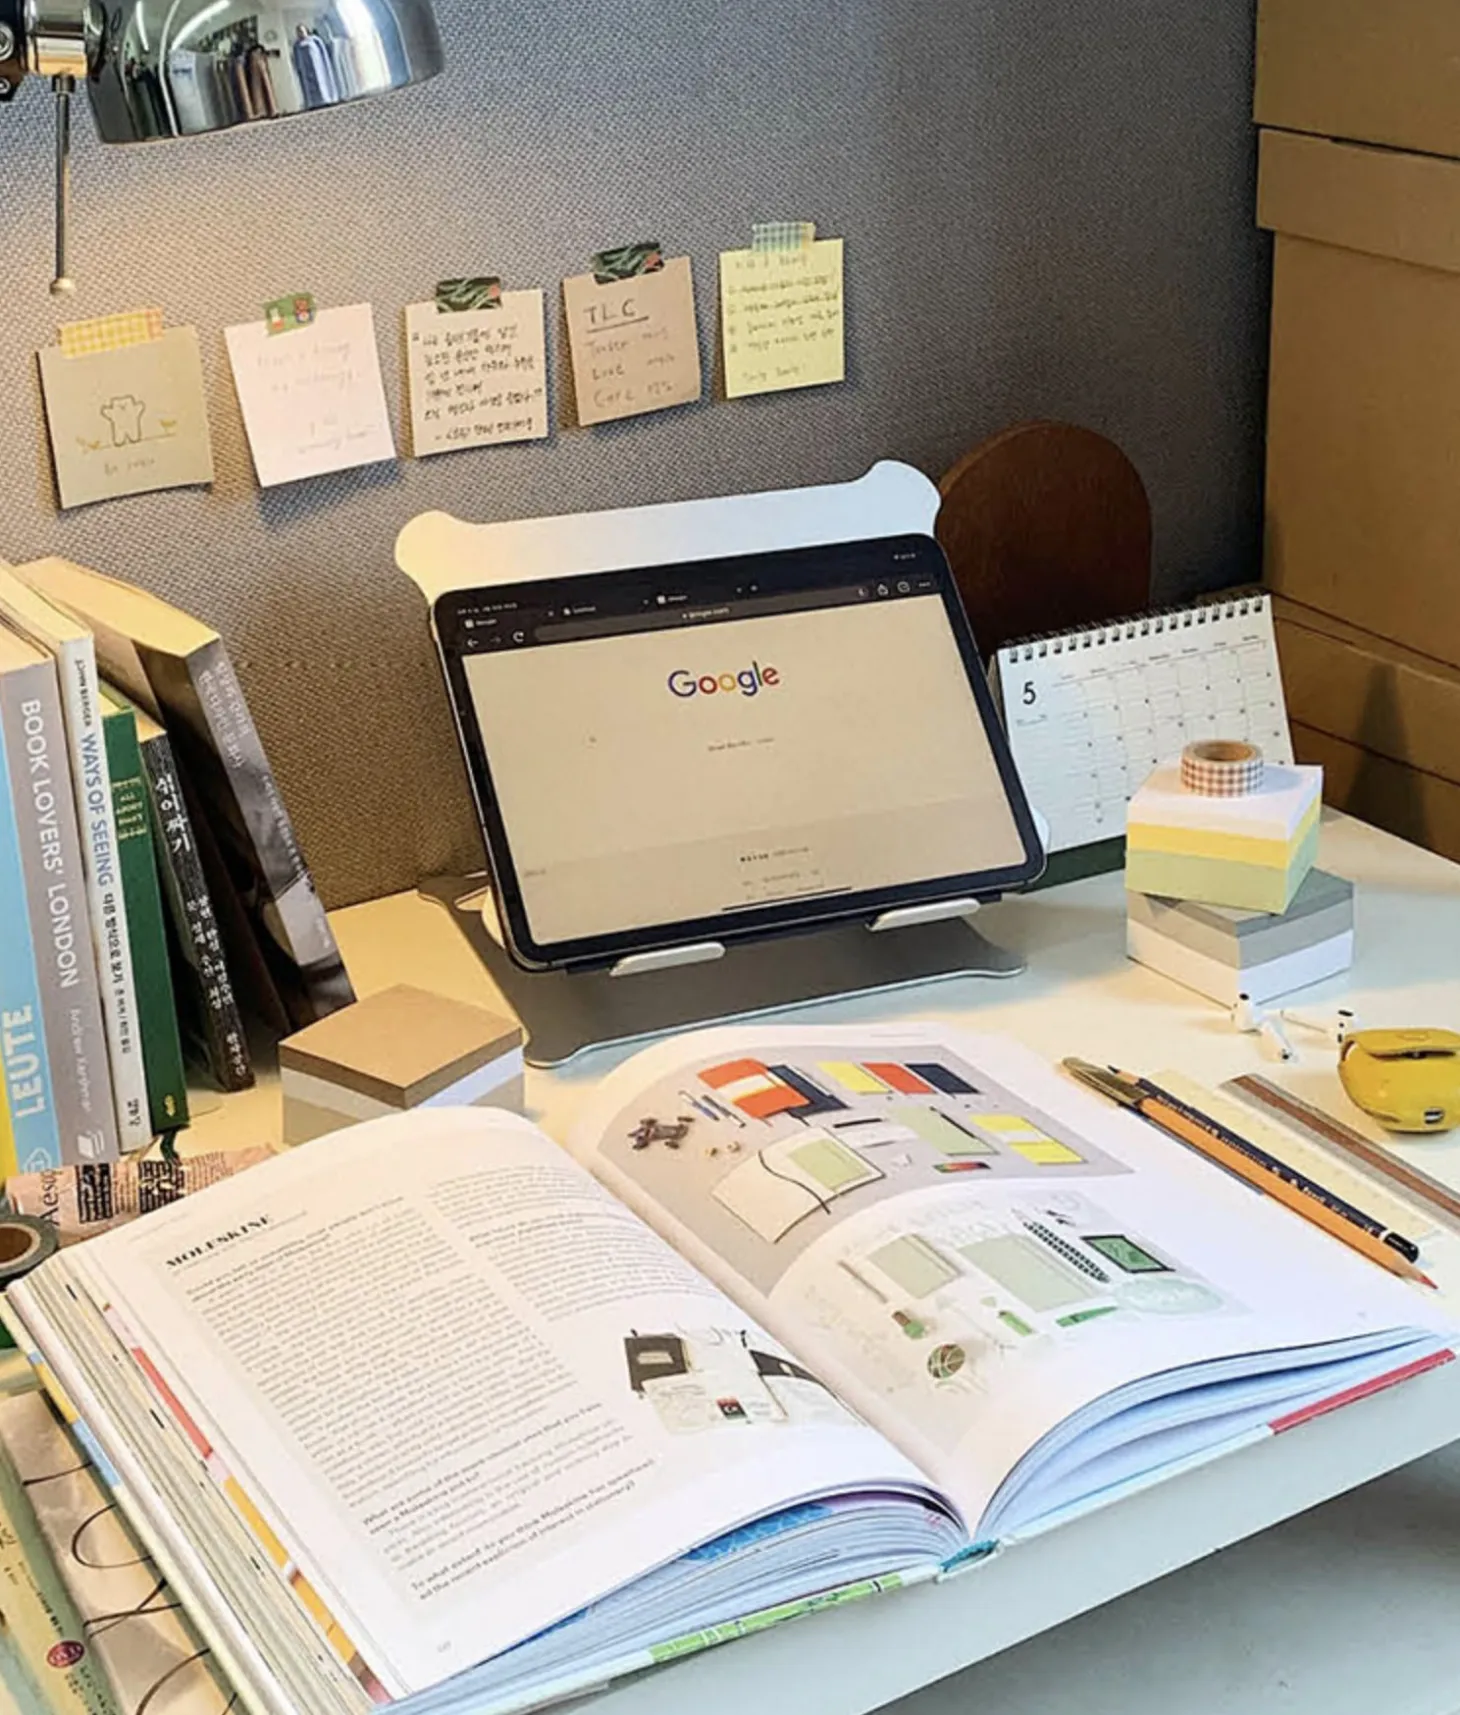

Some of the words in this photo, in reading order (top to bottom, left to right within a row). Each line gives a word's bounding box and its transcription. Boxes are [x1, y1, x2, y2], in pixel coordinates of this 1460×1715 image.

[583, 299, 636, 325] TLC
[668, 660, 780, 697] Google
[1023, 681, 1037, 705] 5
[21, 698, 50, 774] BOOK
[81, 731, 101, 788] WAYS
[32, 779, 65, 877] LOVERS'
[87, 789, 105, 814] OF
[91, 821, 114, 887] SEEING
[48, 883, 79, 989] LONDON
[4, 1004, 45, 1119] LEUTE
[166, 1213, 269, 1267] MOLESKINE
